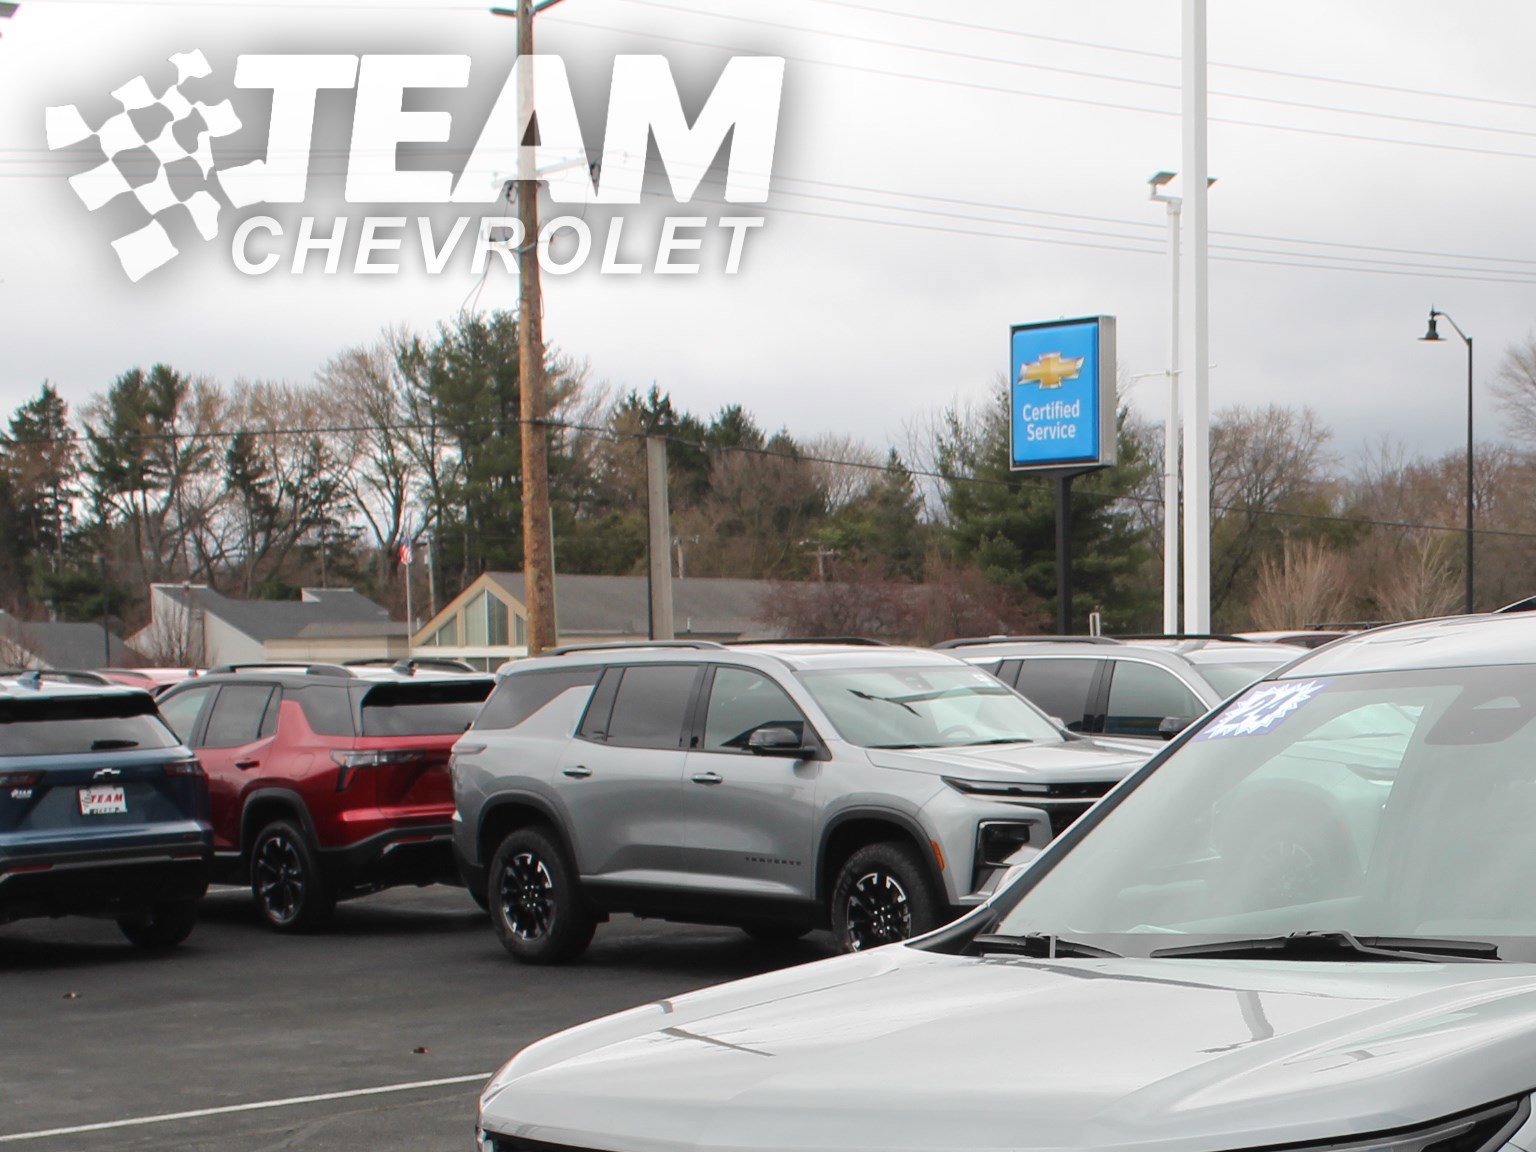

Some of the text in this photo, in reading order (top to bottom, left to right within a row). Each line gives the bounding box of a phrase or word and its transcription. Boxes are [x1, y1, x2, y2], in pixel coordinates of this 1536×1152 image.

[1022, 399, 1080, 421] Certified
[1027, 421, 1076, 441] Service
[91, 794, 123, 804] TEAM
